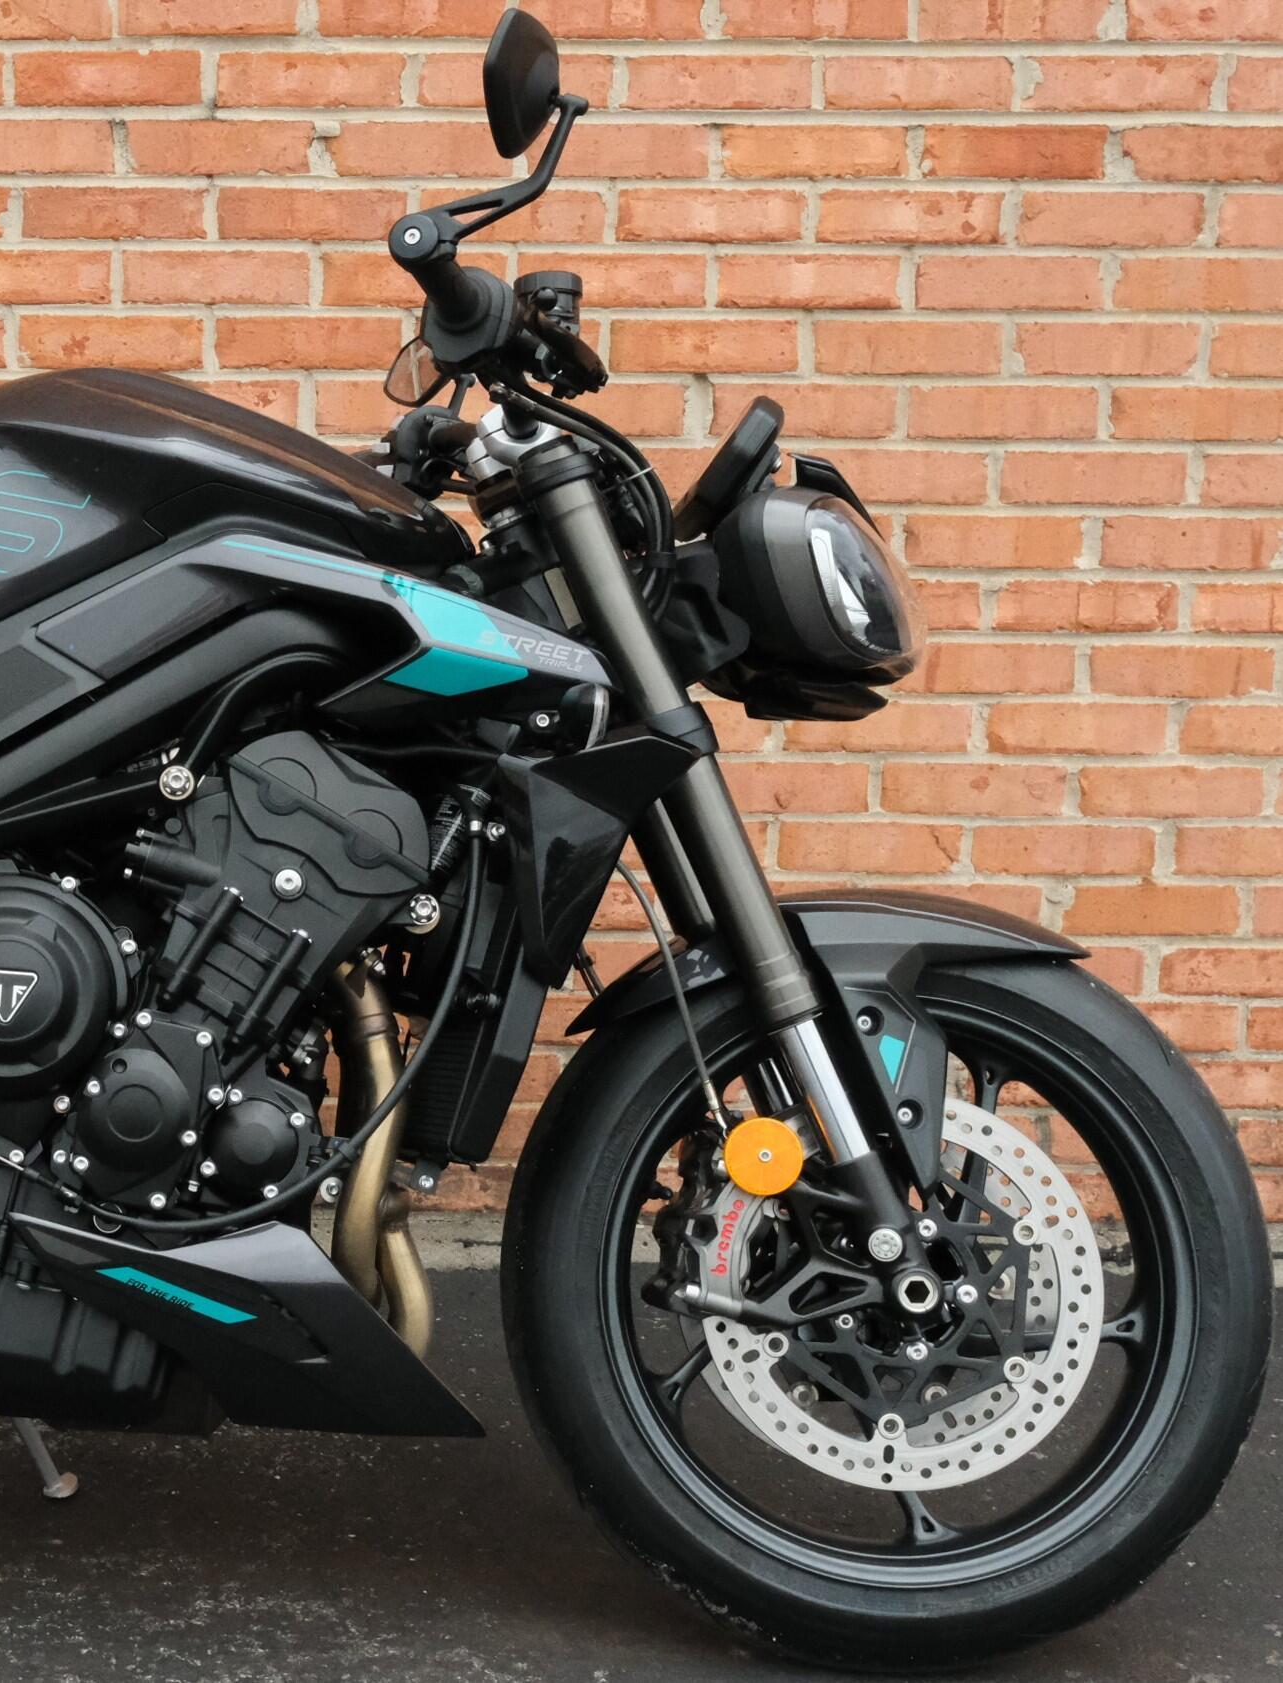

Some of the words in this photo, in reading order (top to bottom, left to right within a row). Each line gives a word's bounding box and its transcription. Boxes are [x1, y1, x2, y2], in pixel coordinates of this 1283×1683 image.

[480, 631, 589, 663] STREET
[538, 655, 583, 673] TRIPLE
[710, 1199, 745, 1278] brembo
